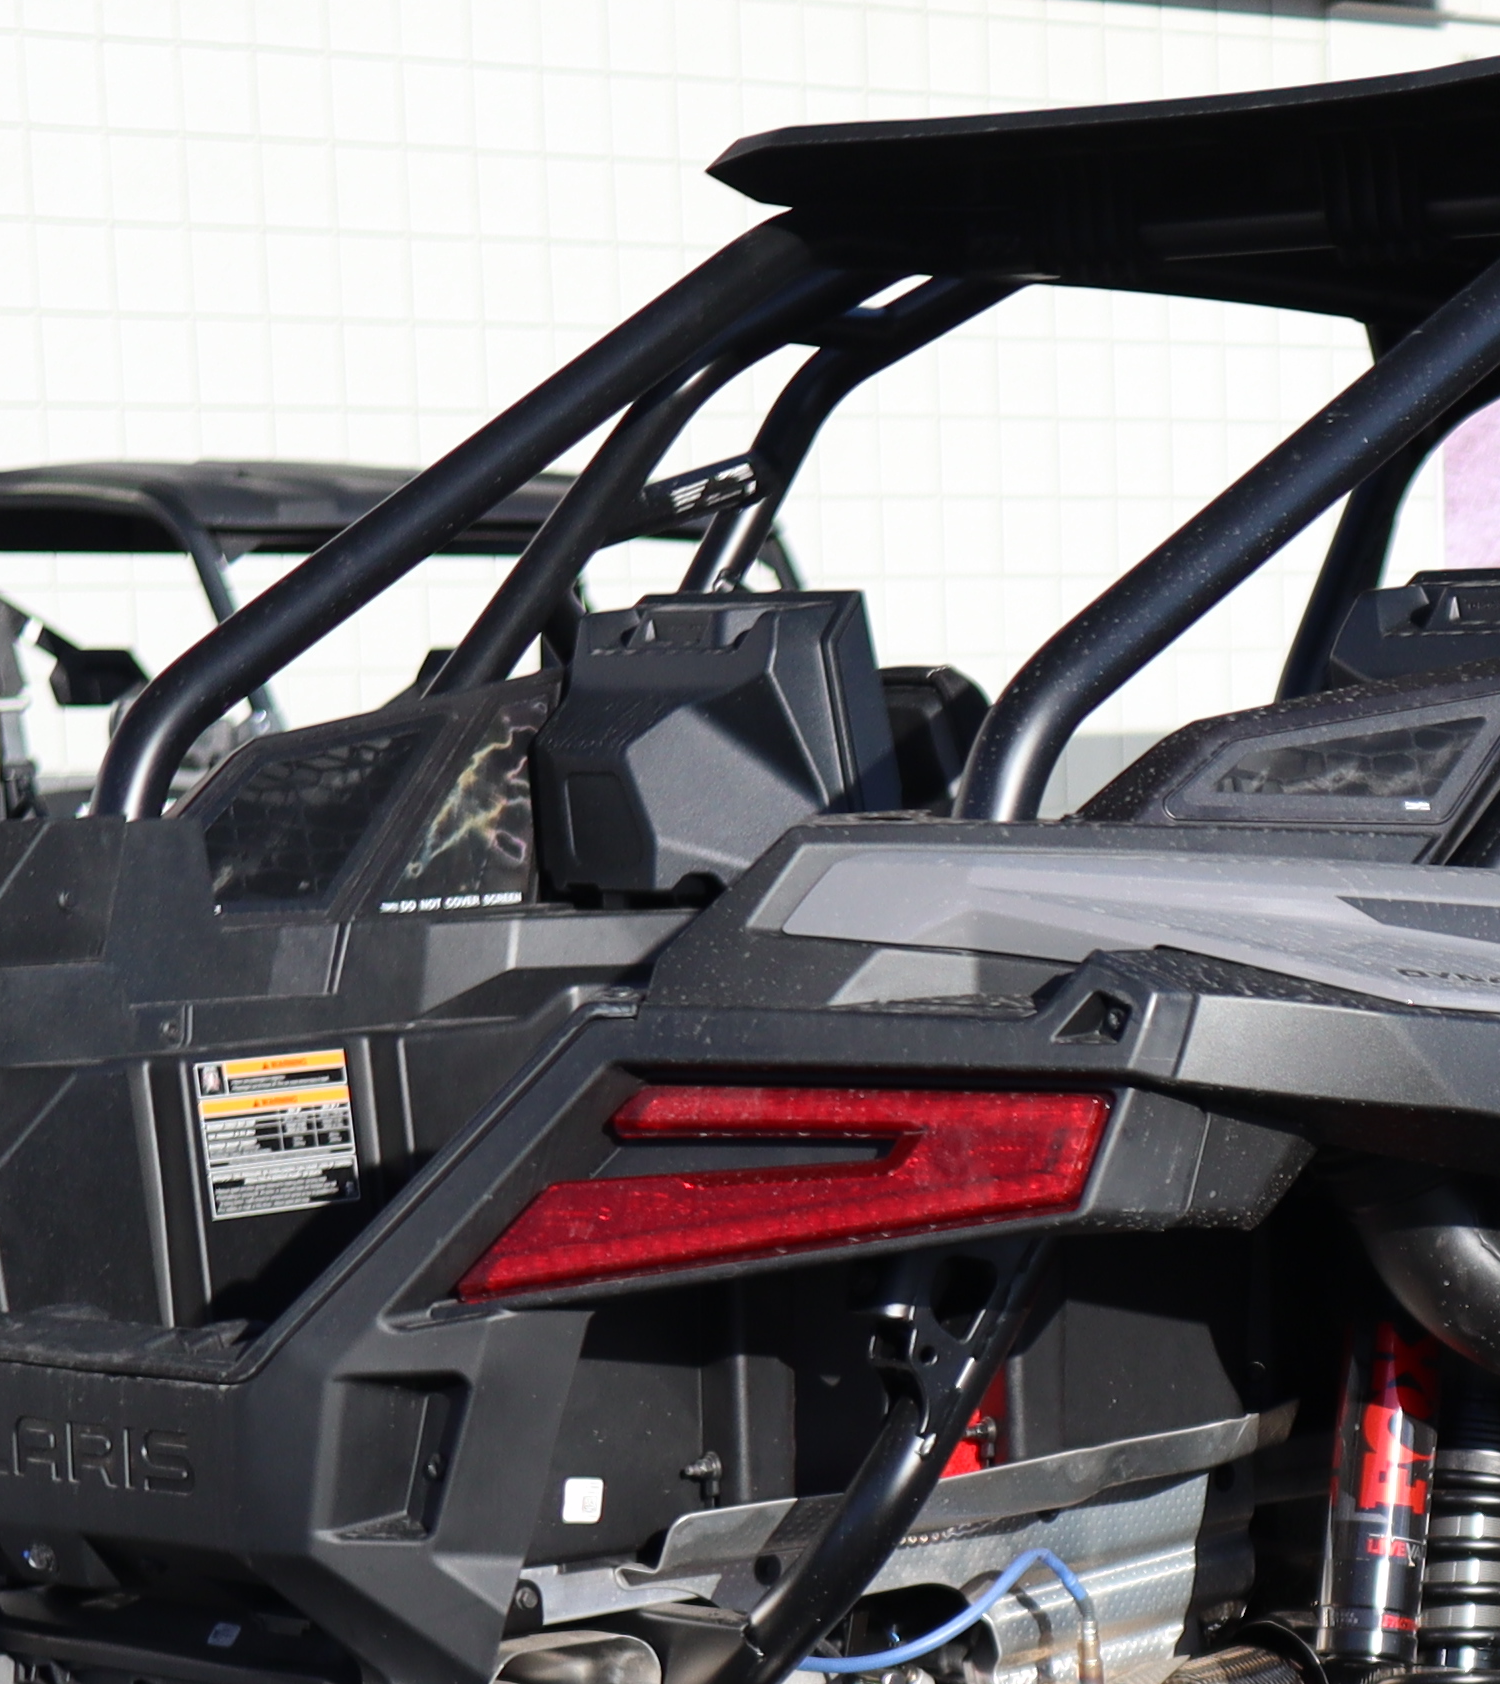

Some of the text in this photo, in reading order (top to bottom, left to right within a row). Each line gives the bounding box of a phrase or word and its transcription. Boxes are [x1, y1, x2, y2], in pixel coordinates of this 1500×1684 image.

[399, 899, 417, 914] DO
[418, 897, 442, 912] NOT
[444, 894, 481, 910] COVER
[483, 891, 522, 907] SCREEN
